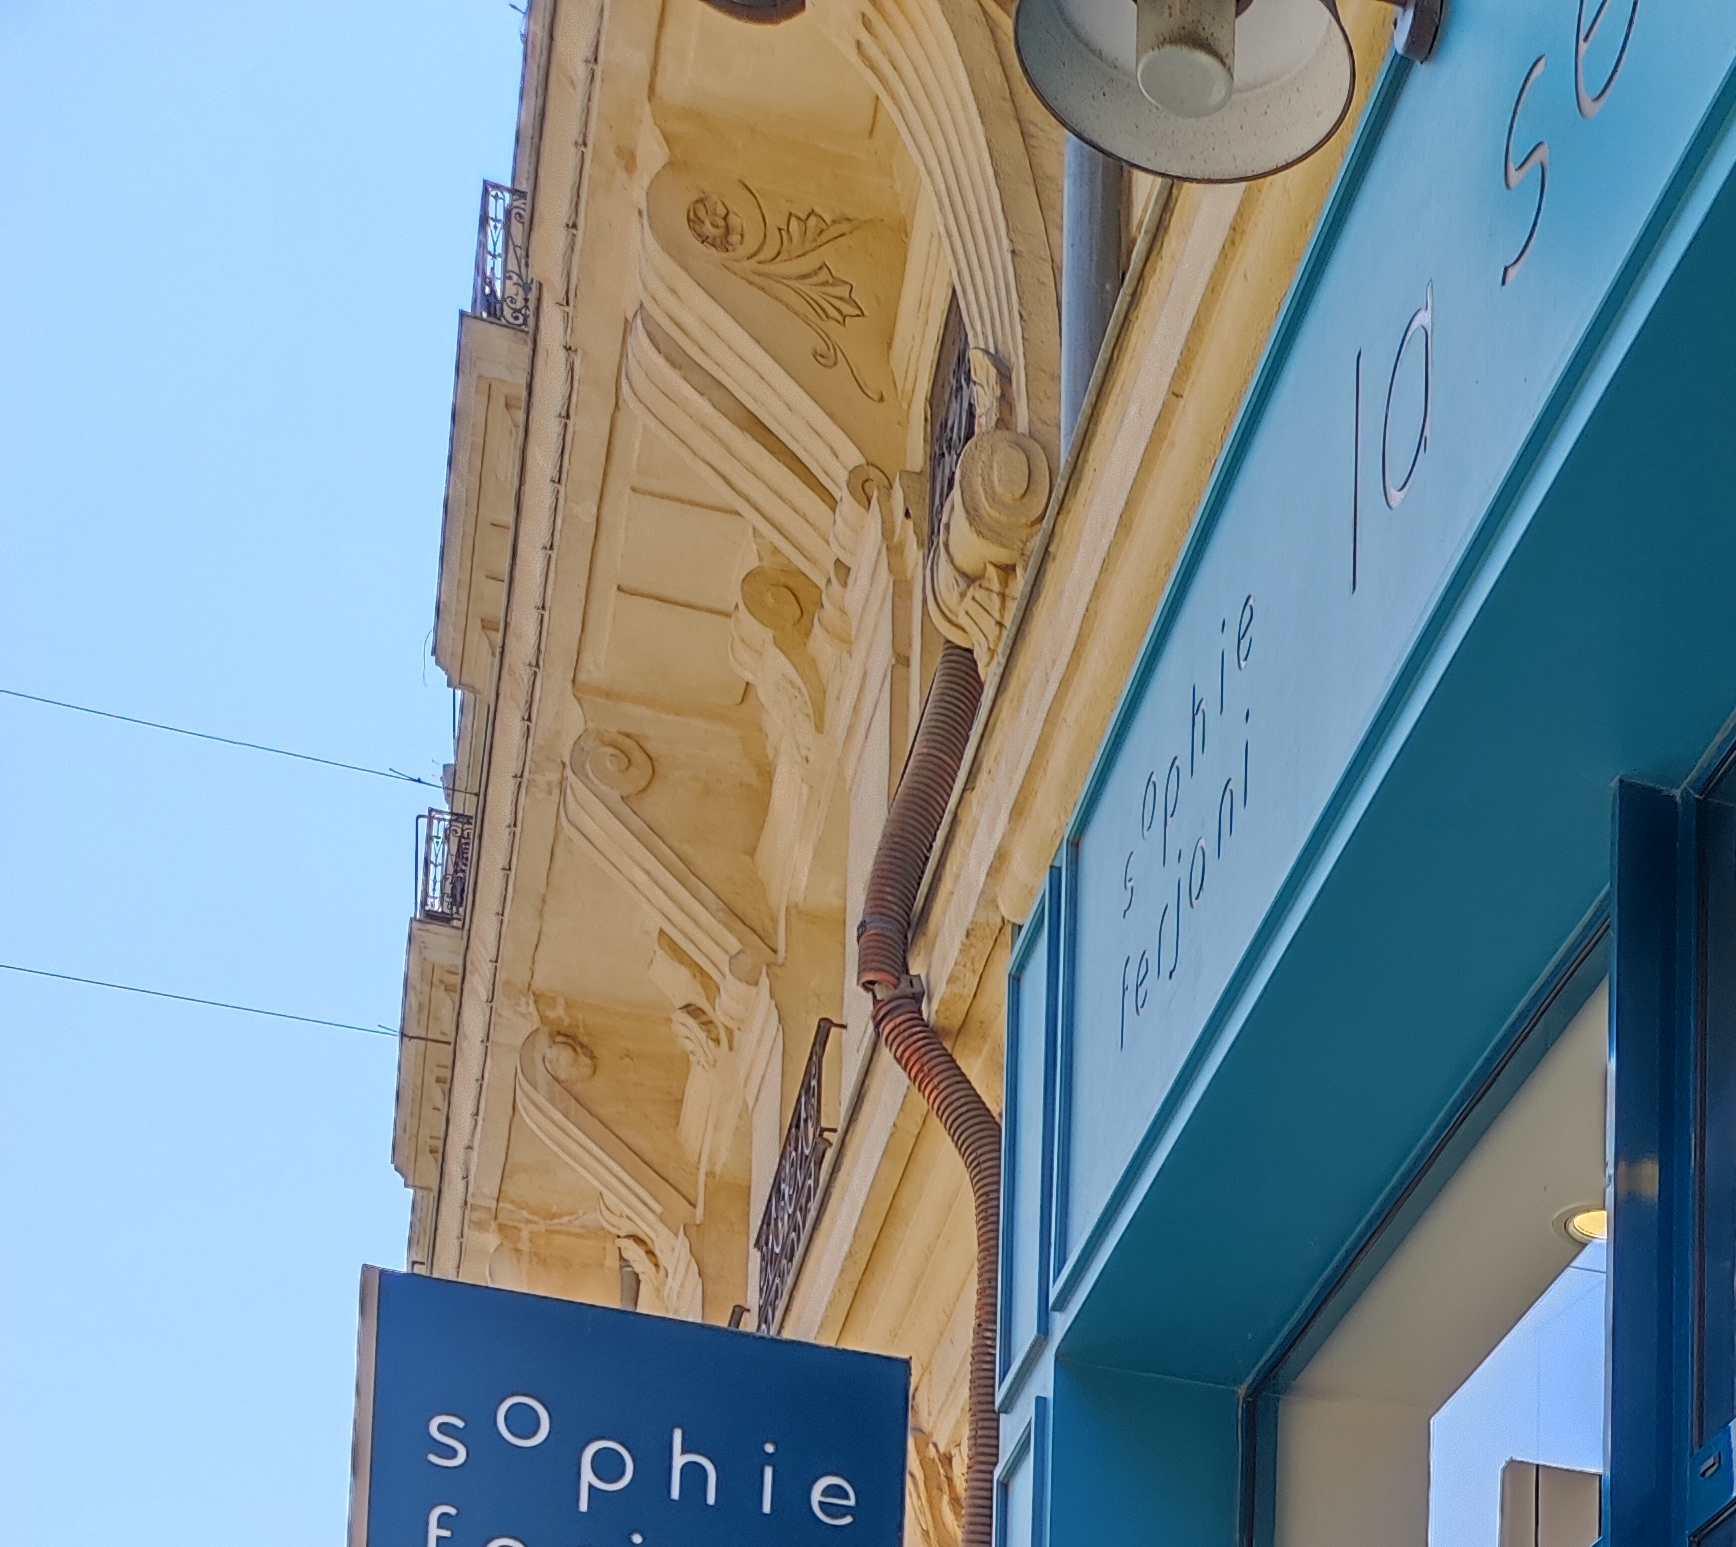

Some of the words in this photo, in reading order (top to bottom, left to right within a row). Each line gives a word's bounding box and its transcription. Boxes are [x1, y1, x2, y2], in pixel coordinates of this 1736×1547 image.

[1351, 277, 1433, 596] la
[1120, 707, 1251, 1053] ferjani
[1121, 593, 1255, 920] sophie
[426, 1394, 857, 1527] sophie
